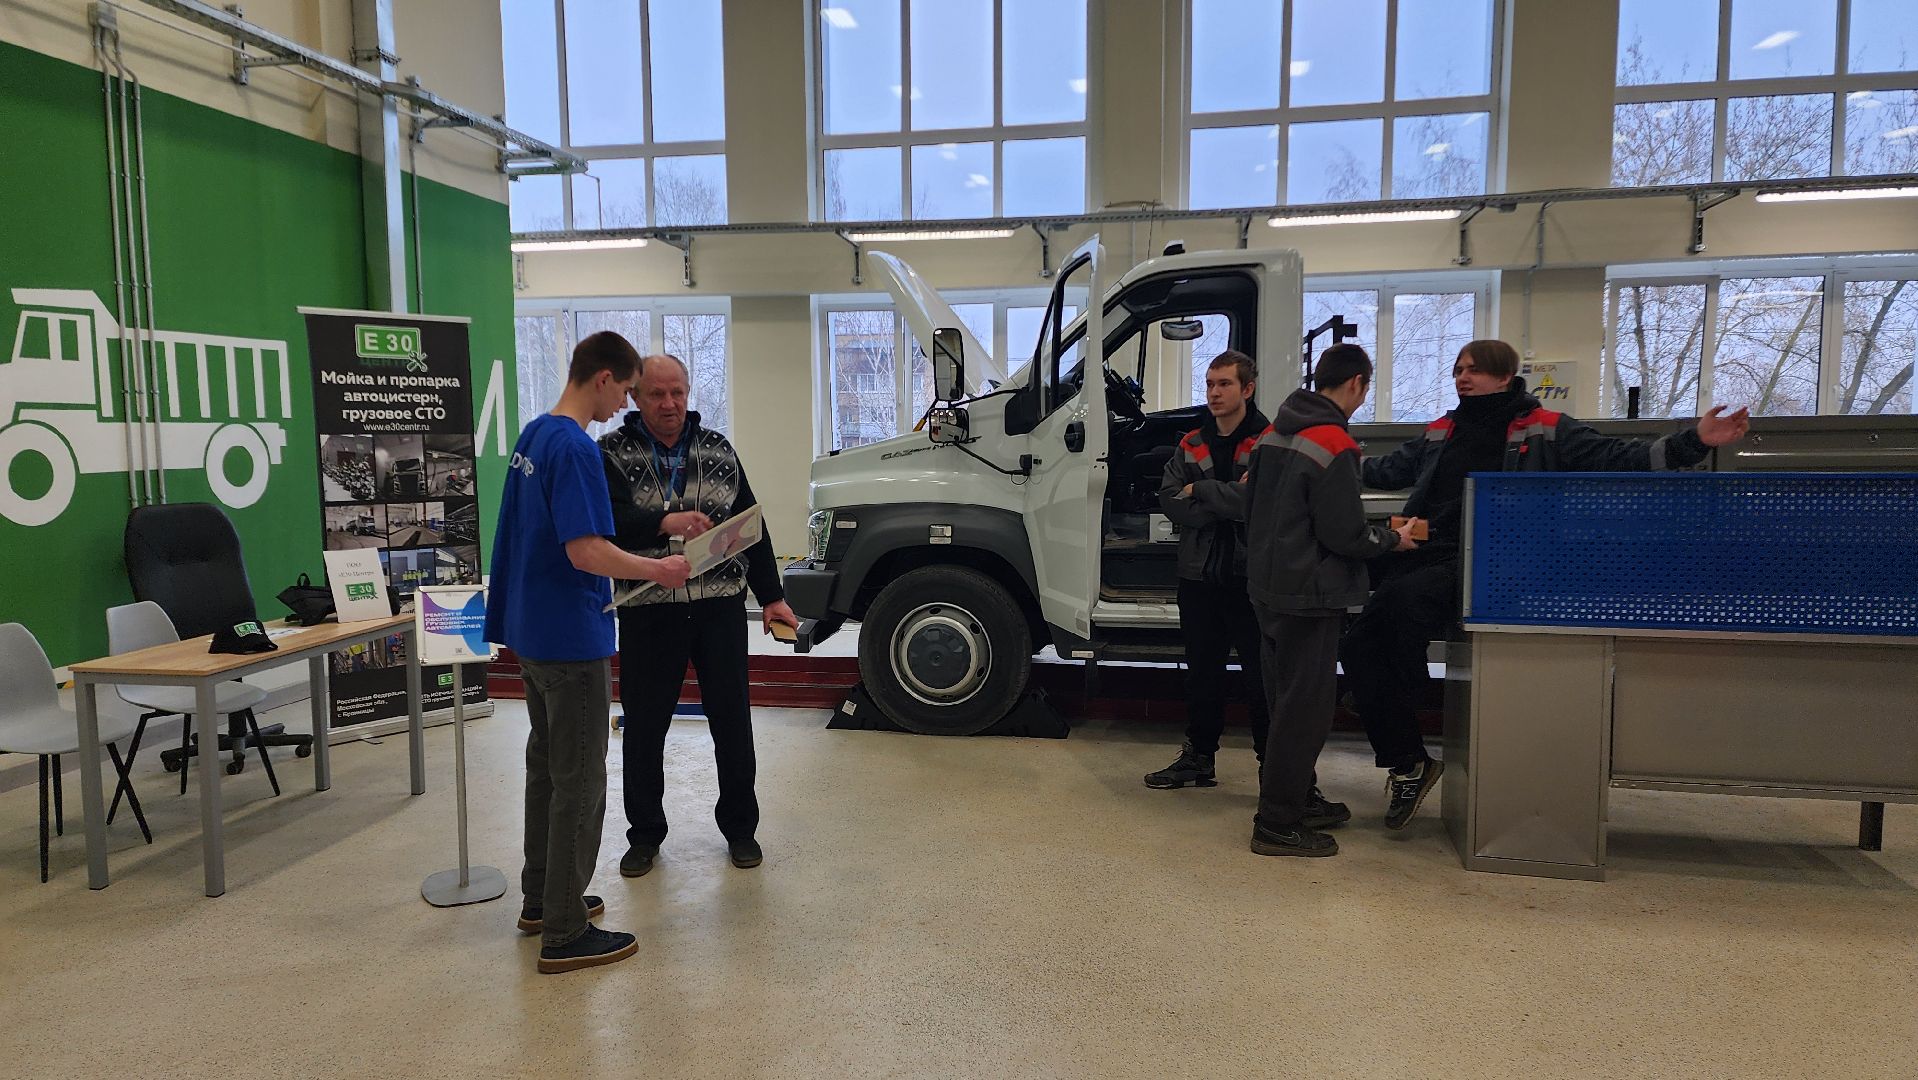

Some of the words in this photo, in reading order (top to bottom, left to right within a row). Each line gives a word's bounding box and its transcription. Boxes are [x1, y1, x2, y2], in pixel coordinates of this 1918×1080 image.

[364, 332, 378, 350] E
[386, 334, 412, 352] 30
[321, 371, 374, 386] Мойка
[377, 376, 386, 385] и
[390, 375, 460, 388] пропарка
[343, 391, 443, 405] автоцистерн,
[342, 409, 412, 422] грузовое
[414, 407, 446, 420] СТО
[363, 423, 430, 431] www.e30centr.ru
[349, 586, 357, 595] E
[360, 585, 372, 594] 30
[336, 697, 372, 705] Российская
[336, 702, 373, 711] Московская
